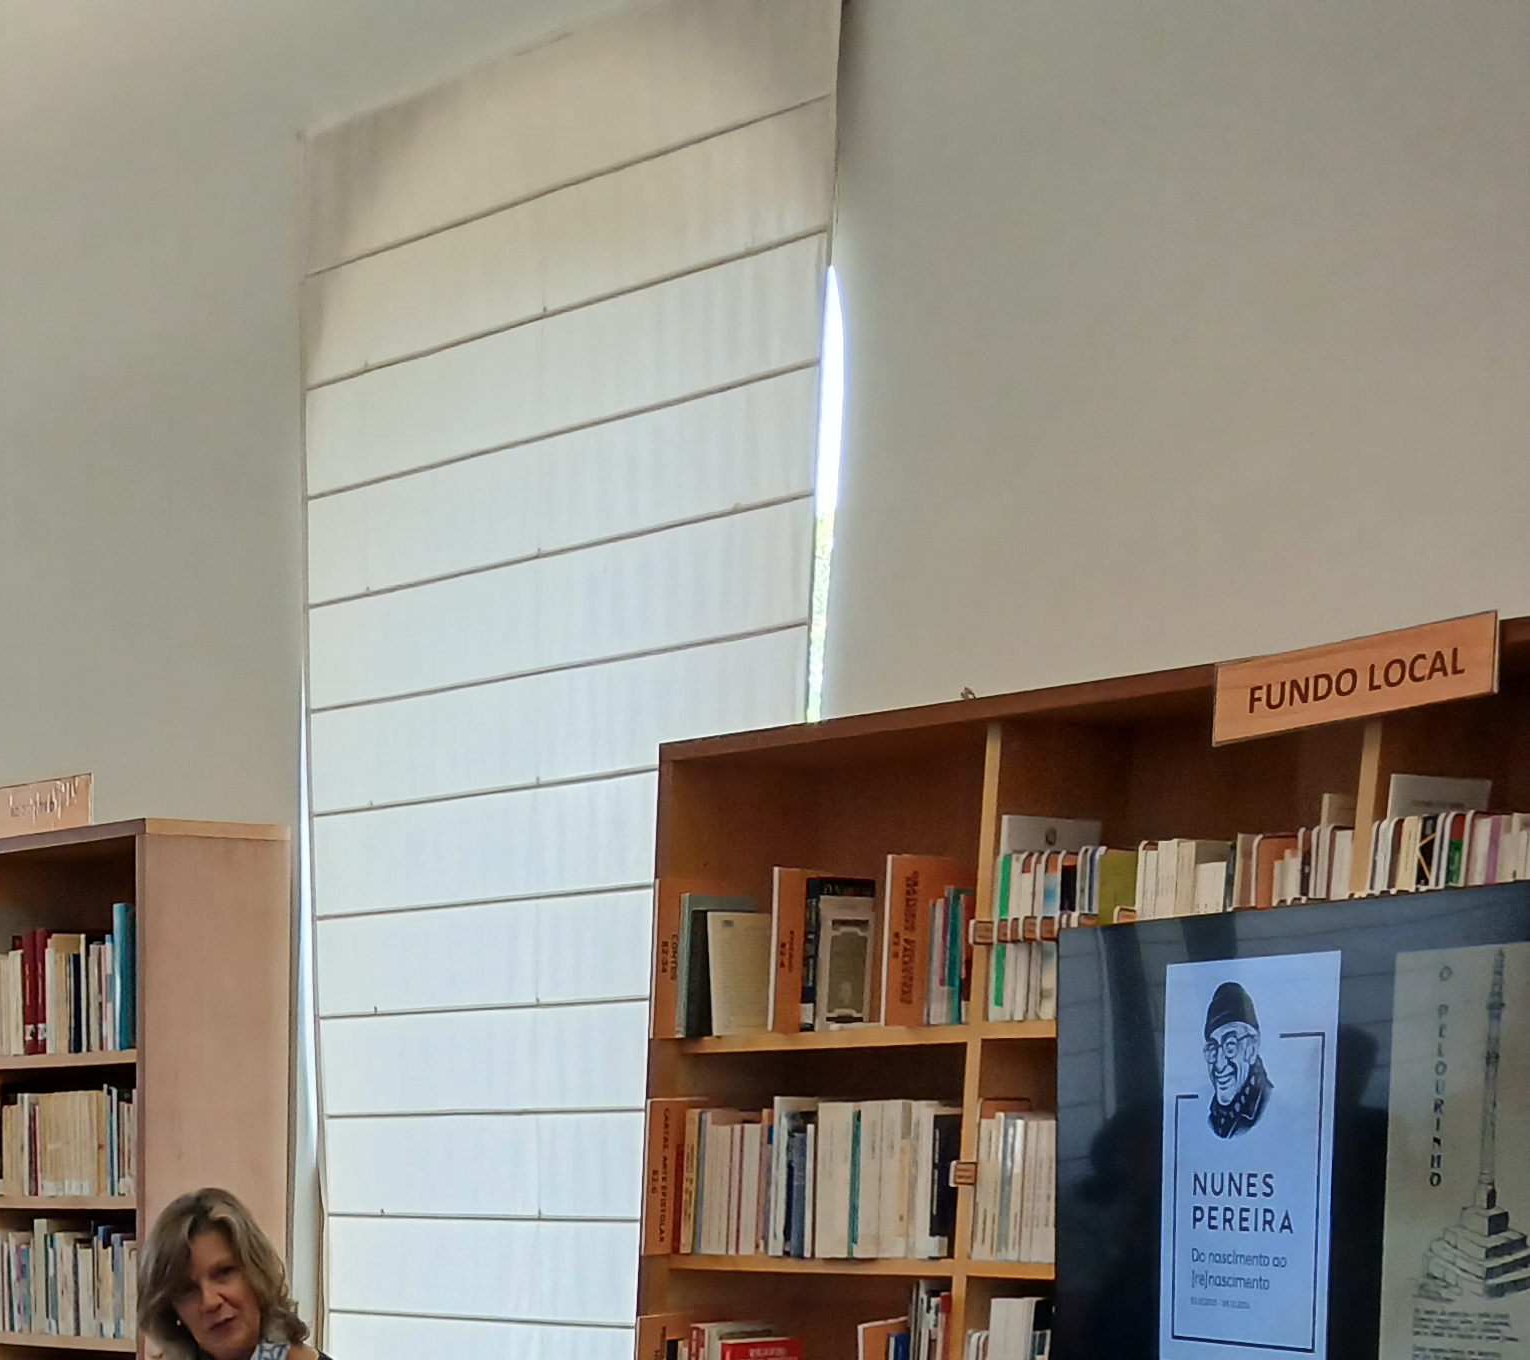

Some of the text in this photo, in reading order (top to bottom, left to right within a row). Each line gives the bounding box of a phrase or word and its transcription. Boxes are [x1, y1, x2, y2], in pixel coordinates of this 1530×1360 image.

[1247, 647, 1465, 714] FUNDO LOCAL
[1192, 1171, 1275, 1198] NUNES
[1191, 1205, 1294, 1234] PEREIRA
[1191, 1247, 1287, 1268] Do nascimento ao
